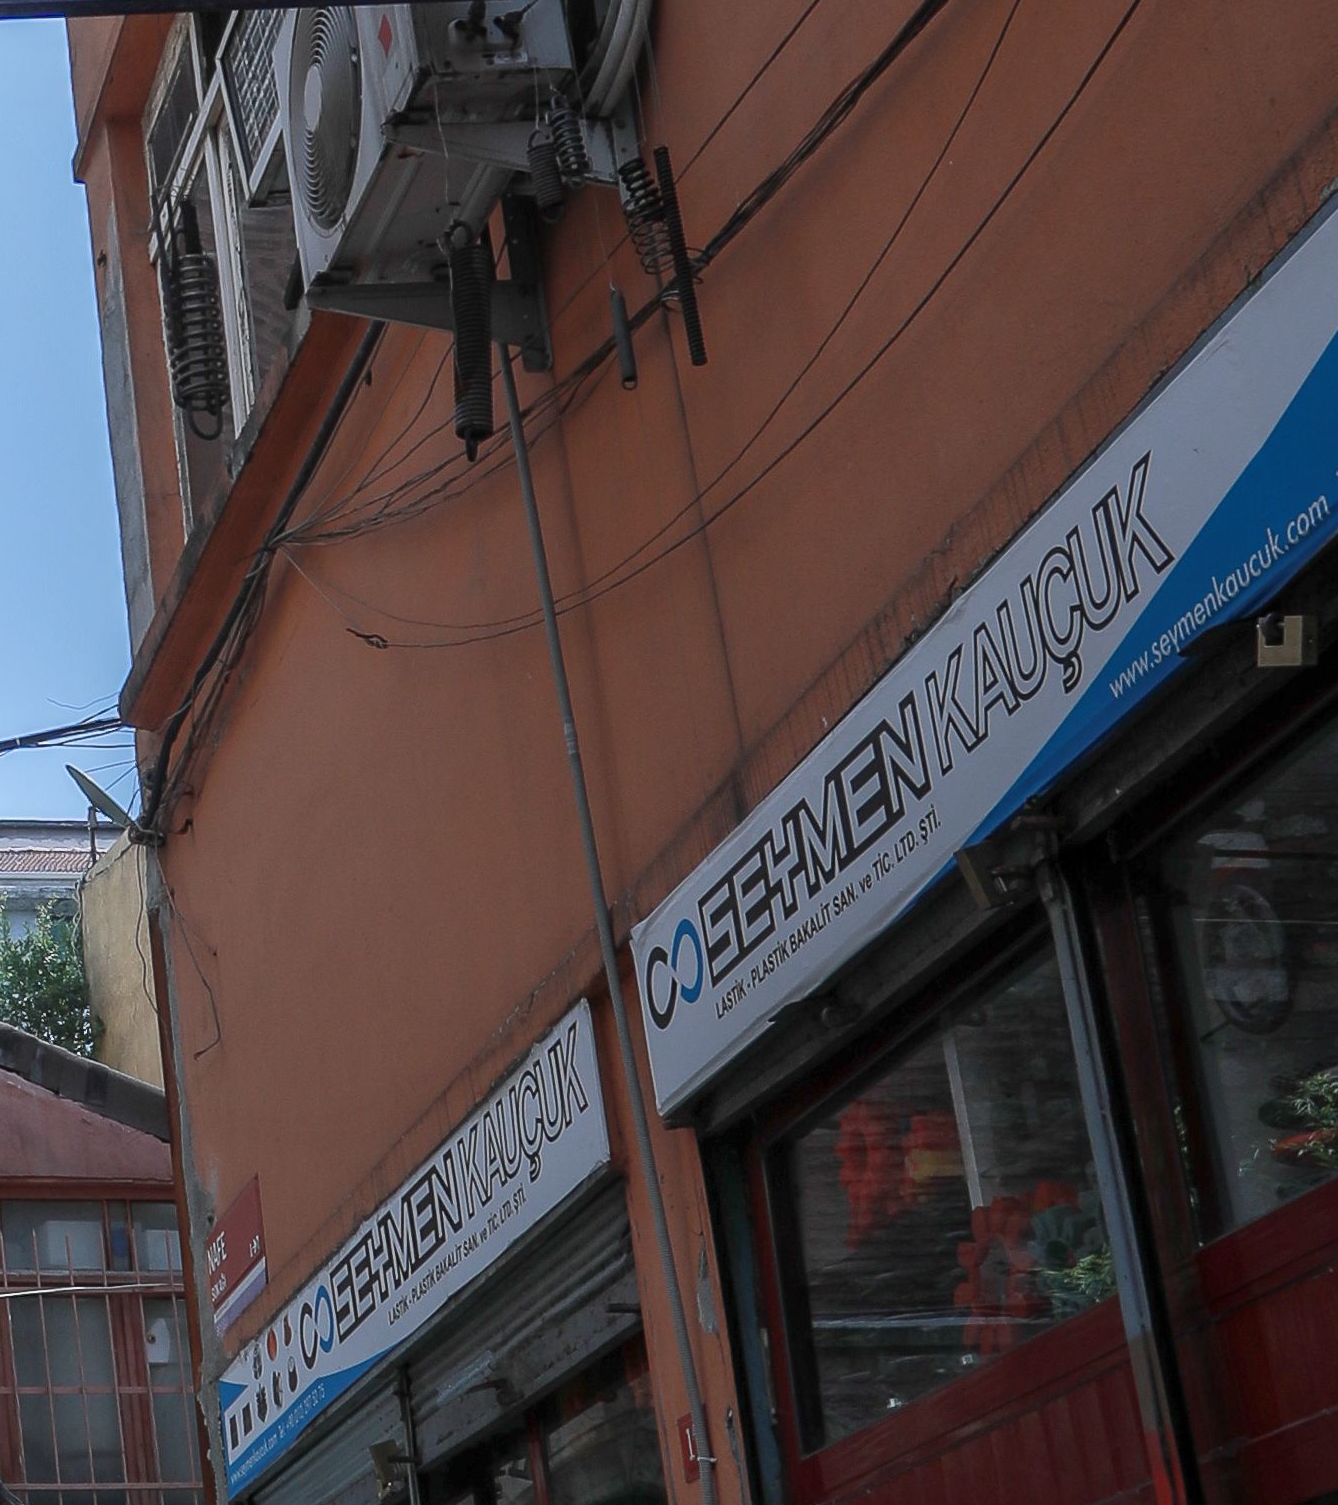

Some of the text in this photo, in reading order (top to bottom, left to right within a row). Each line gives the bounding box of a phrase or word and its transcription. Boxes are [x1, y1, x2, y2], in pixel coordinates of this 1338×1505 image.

[925, 450, 1175, 776] KAUÇUK
[1109, 494, 1330, 698] www.seymenkaucuk.com
[716, 980, 747, 1019] LASTİK
[751, 941, 789, 988] PLASTİK
[790, 903, 832, 953] BAKALİT
[833, 887, 859, 917] SAN.
[859, 877, 872, 894] ve
[872, 852, 894, 881] TİC.
[895, 832, 919, 863] LTD.
